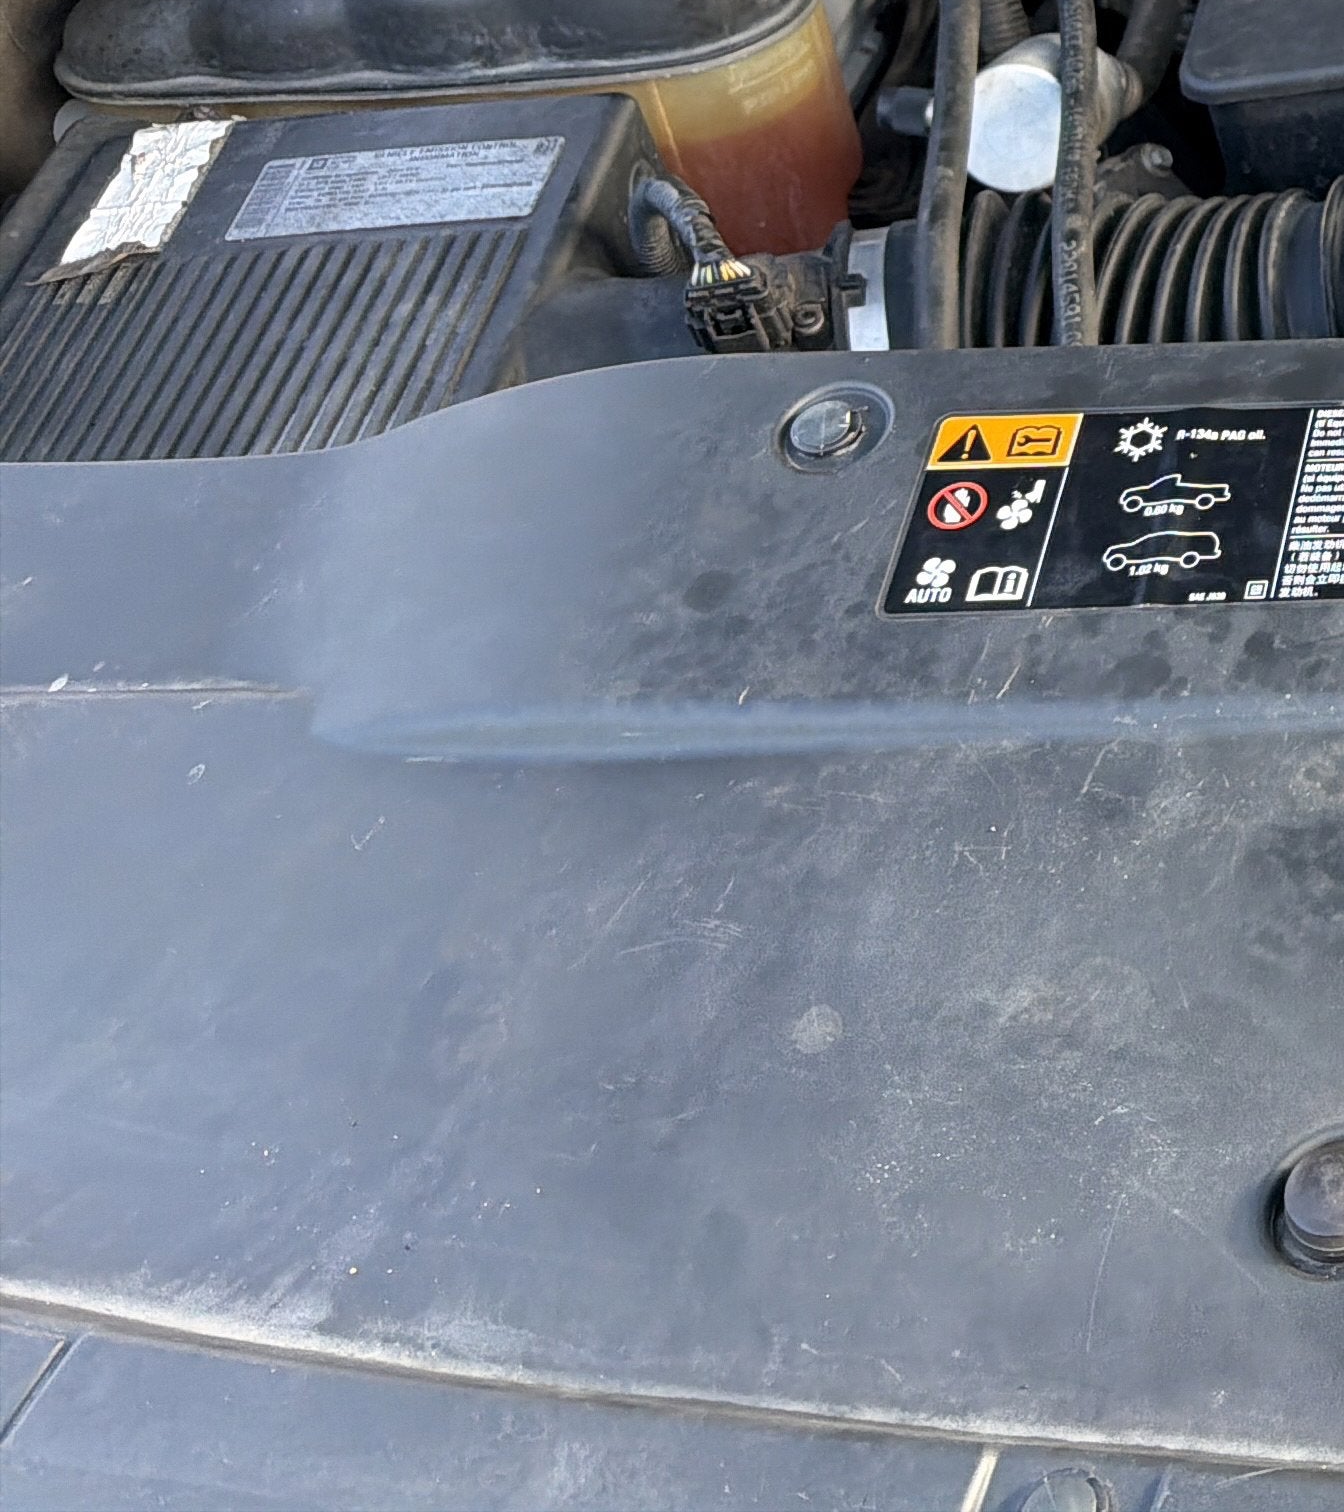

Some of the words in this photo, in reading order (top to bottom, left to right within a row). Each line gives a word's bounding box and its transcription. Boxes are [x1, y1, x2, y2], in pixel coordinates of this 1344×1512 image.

[1174, 427, 1219, 441] R-134a
[1246, 428, 1266, 441] oil.
[1311, 427, 1326, 438] Do
[1325, 427, 1343, 438] not
[1167, 504, 1185, 516] kg
[1128, 562, 1153, 577] 1.02
[1151, 562, 1170, 576] kg
[904, 586, 952, 604] AUTO
